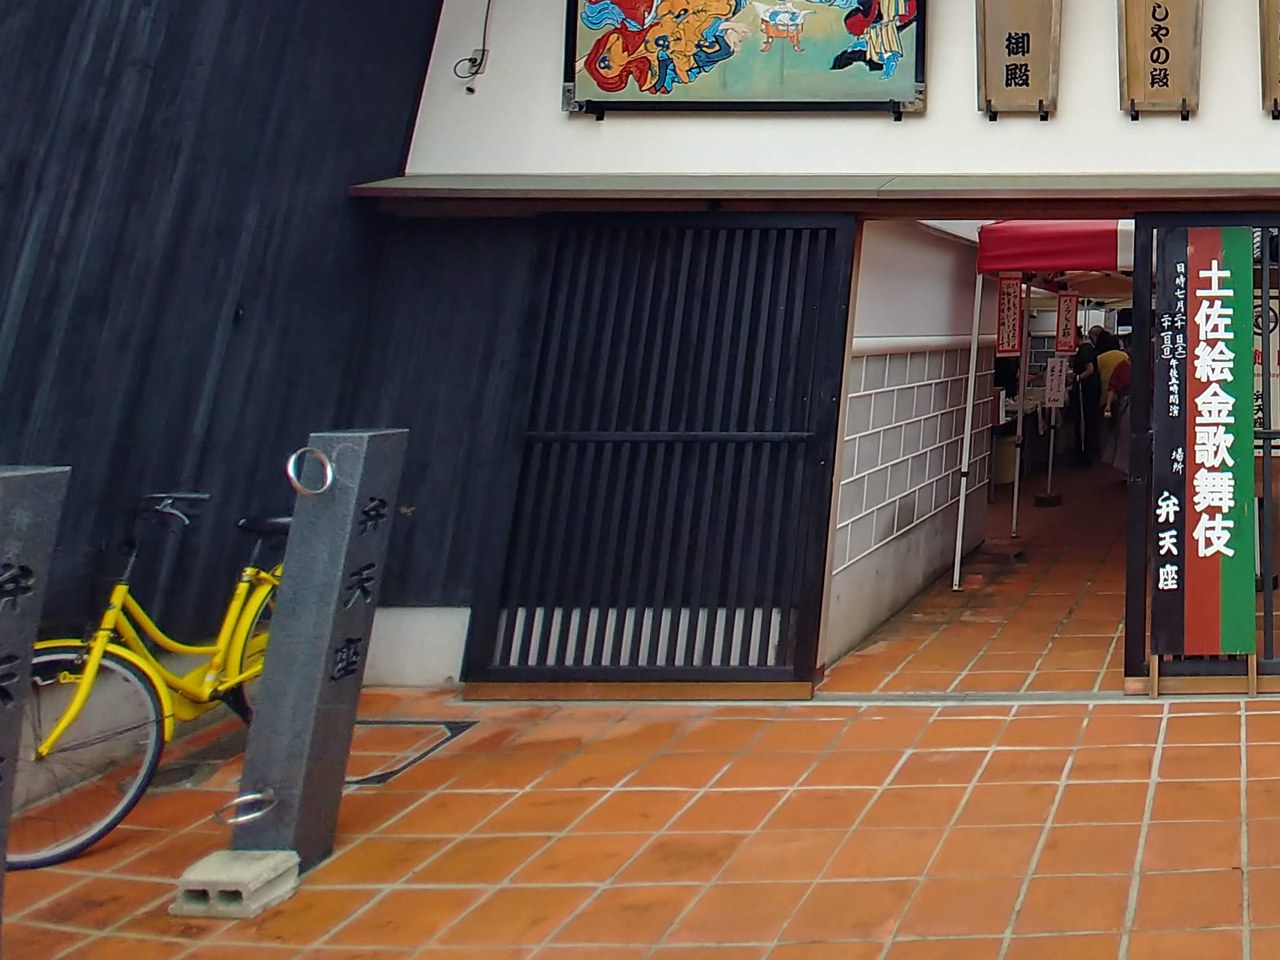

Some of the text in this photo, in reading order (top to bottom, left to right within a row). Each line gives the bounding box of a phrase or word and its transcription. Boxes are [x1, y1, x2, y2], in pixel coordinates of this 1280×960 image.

[1004, 31, 1031, 89] 御殿
[1192, 259, 1236, 558] 土佐絵金歌舞伎
[1170, 447, 1184, 476] 場所
[329, 496, 390, 684] 弁天座
[1155, 491, 1181, 590] 弁天座
